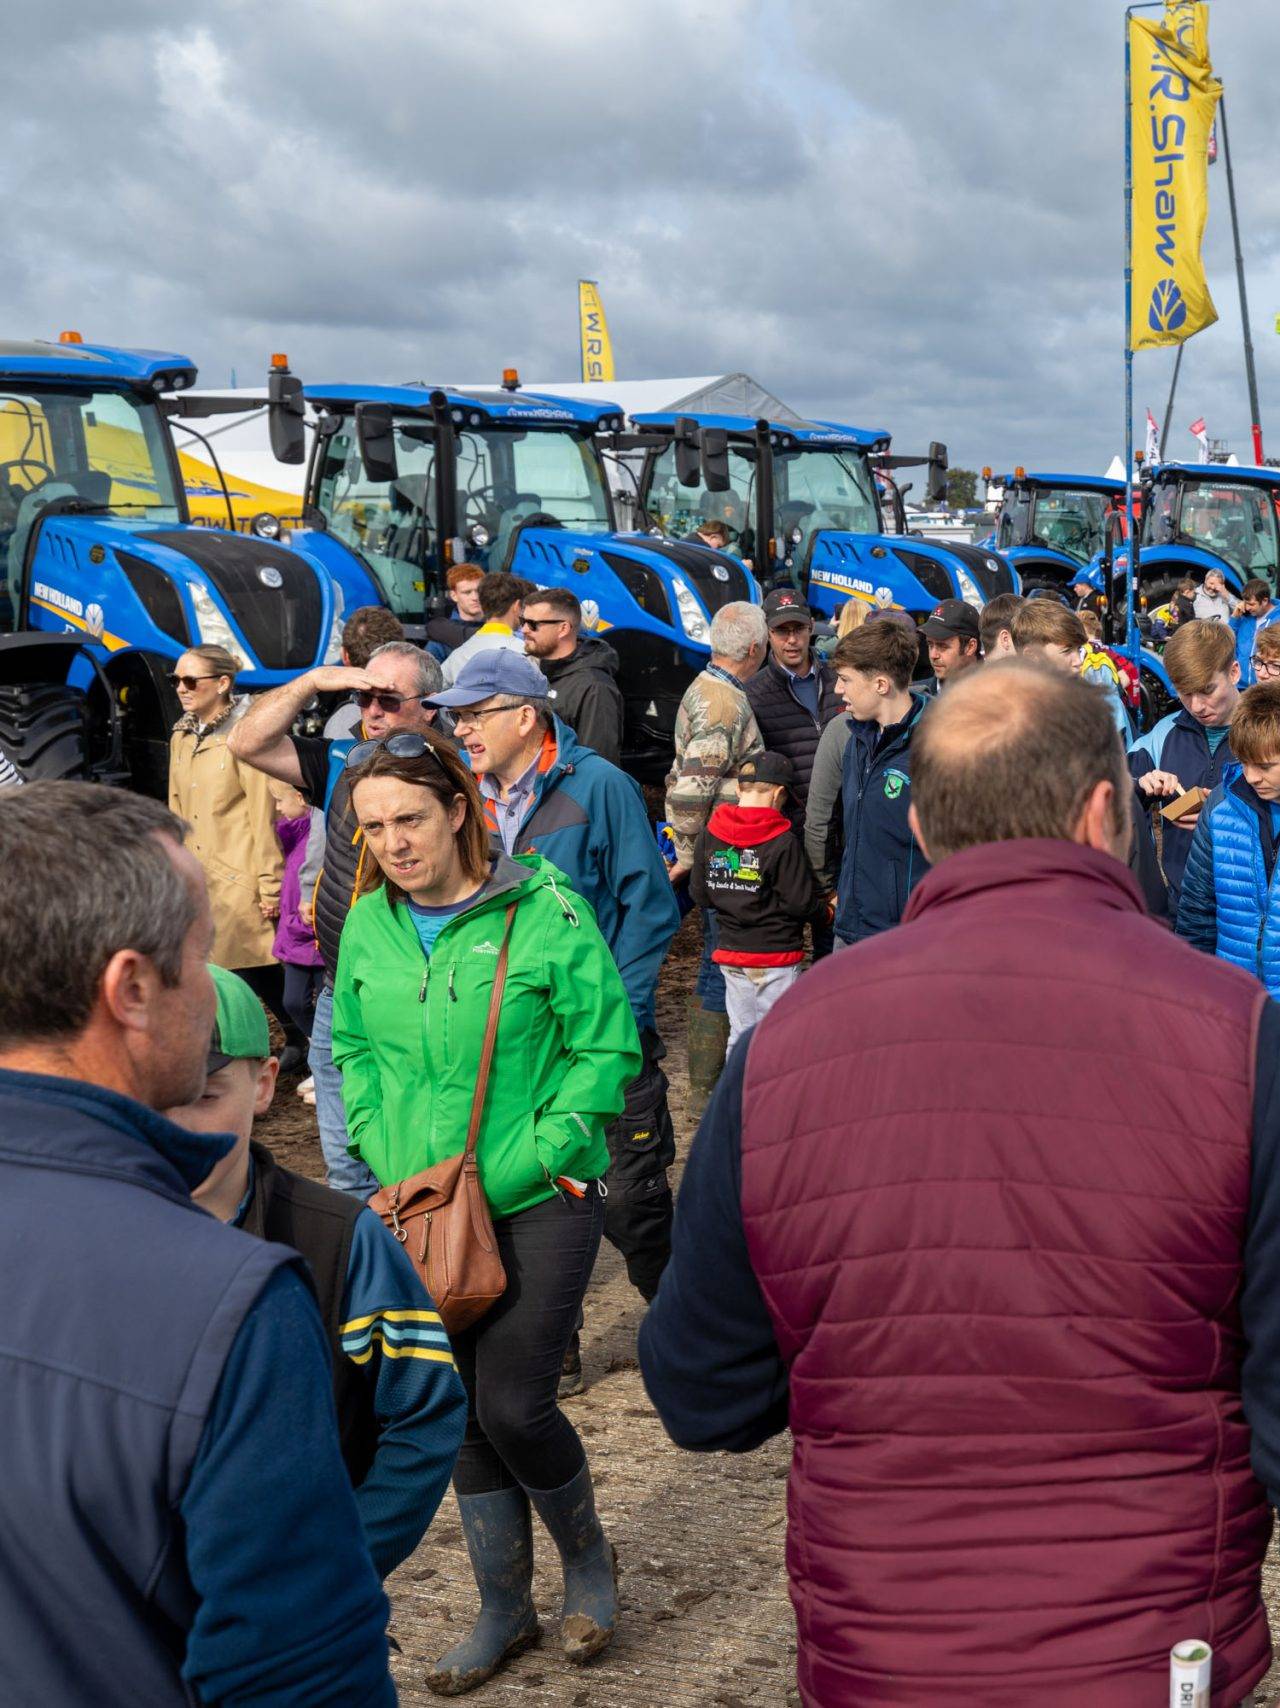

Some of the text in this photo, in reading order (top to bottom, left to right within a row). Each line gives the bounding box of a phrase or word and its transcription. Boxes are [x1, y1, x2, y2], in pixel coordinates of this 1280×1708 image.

[1150, 37, 1190, 267] .R.Shaw
[34, 581, 83, 617] NEW HOLLAND
[811, 569, 874, 595] NEW HOLLAND
